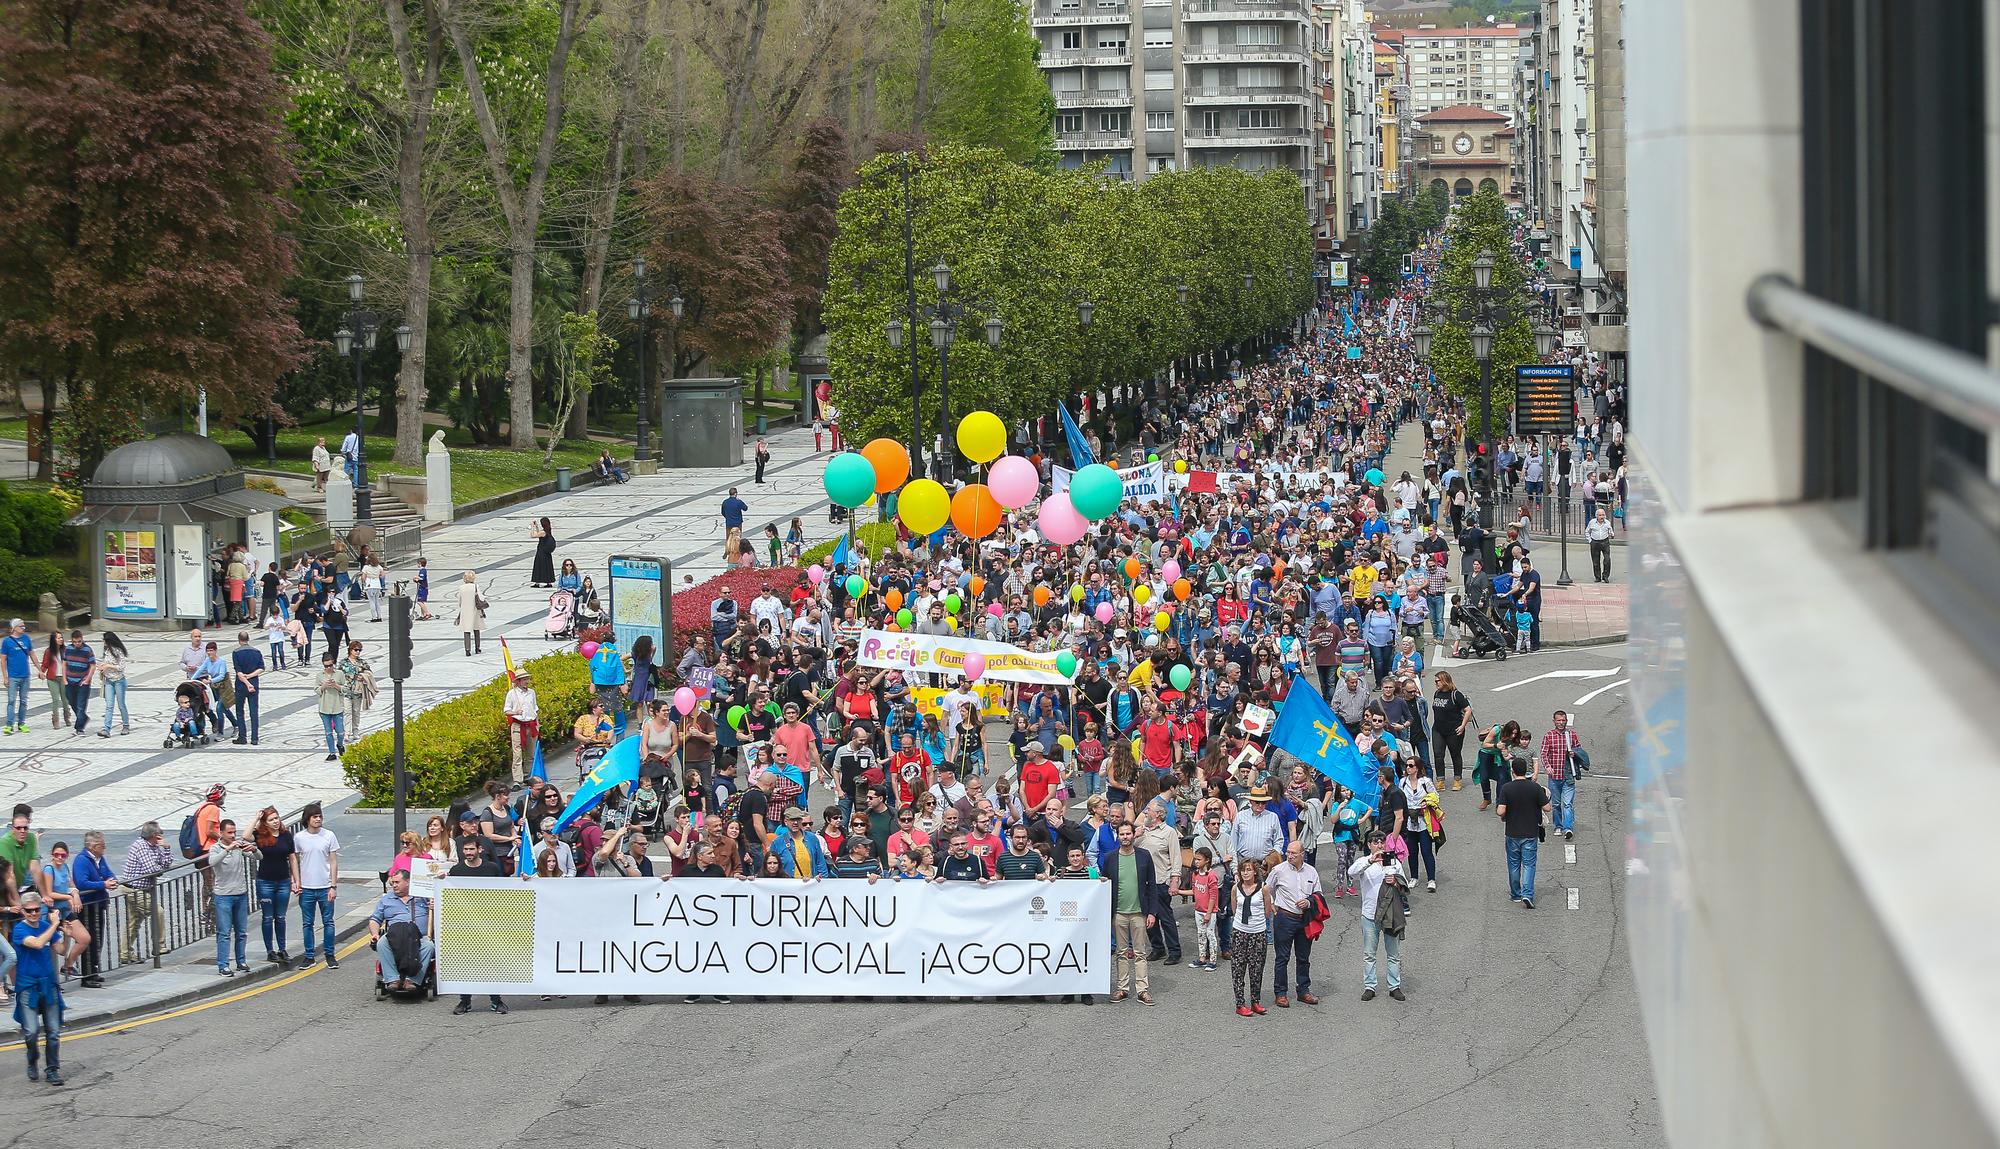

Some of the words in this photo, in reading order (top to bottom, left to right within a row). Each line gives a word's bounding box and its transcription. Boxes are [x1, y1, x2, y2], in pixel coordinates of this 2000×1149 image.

[864, 638, 930, 667] Reciella
[939, 650, 965, 666] fami
[988, 654, 1008, 670] pol
[1011, 656, 1058, 671] asturian
[634, 893, 895, 927] L'ASTURIANU
[557, 941, 729, 973] LLINGUA
[746, 941, 905, 974] OFICIAL
[921, 942, 1087, 983] ¡AGORA!
